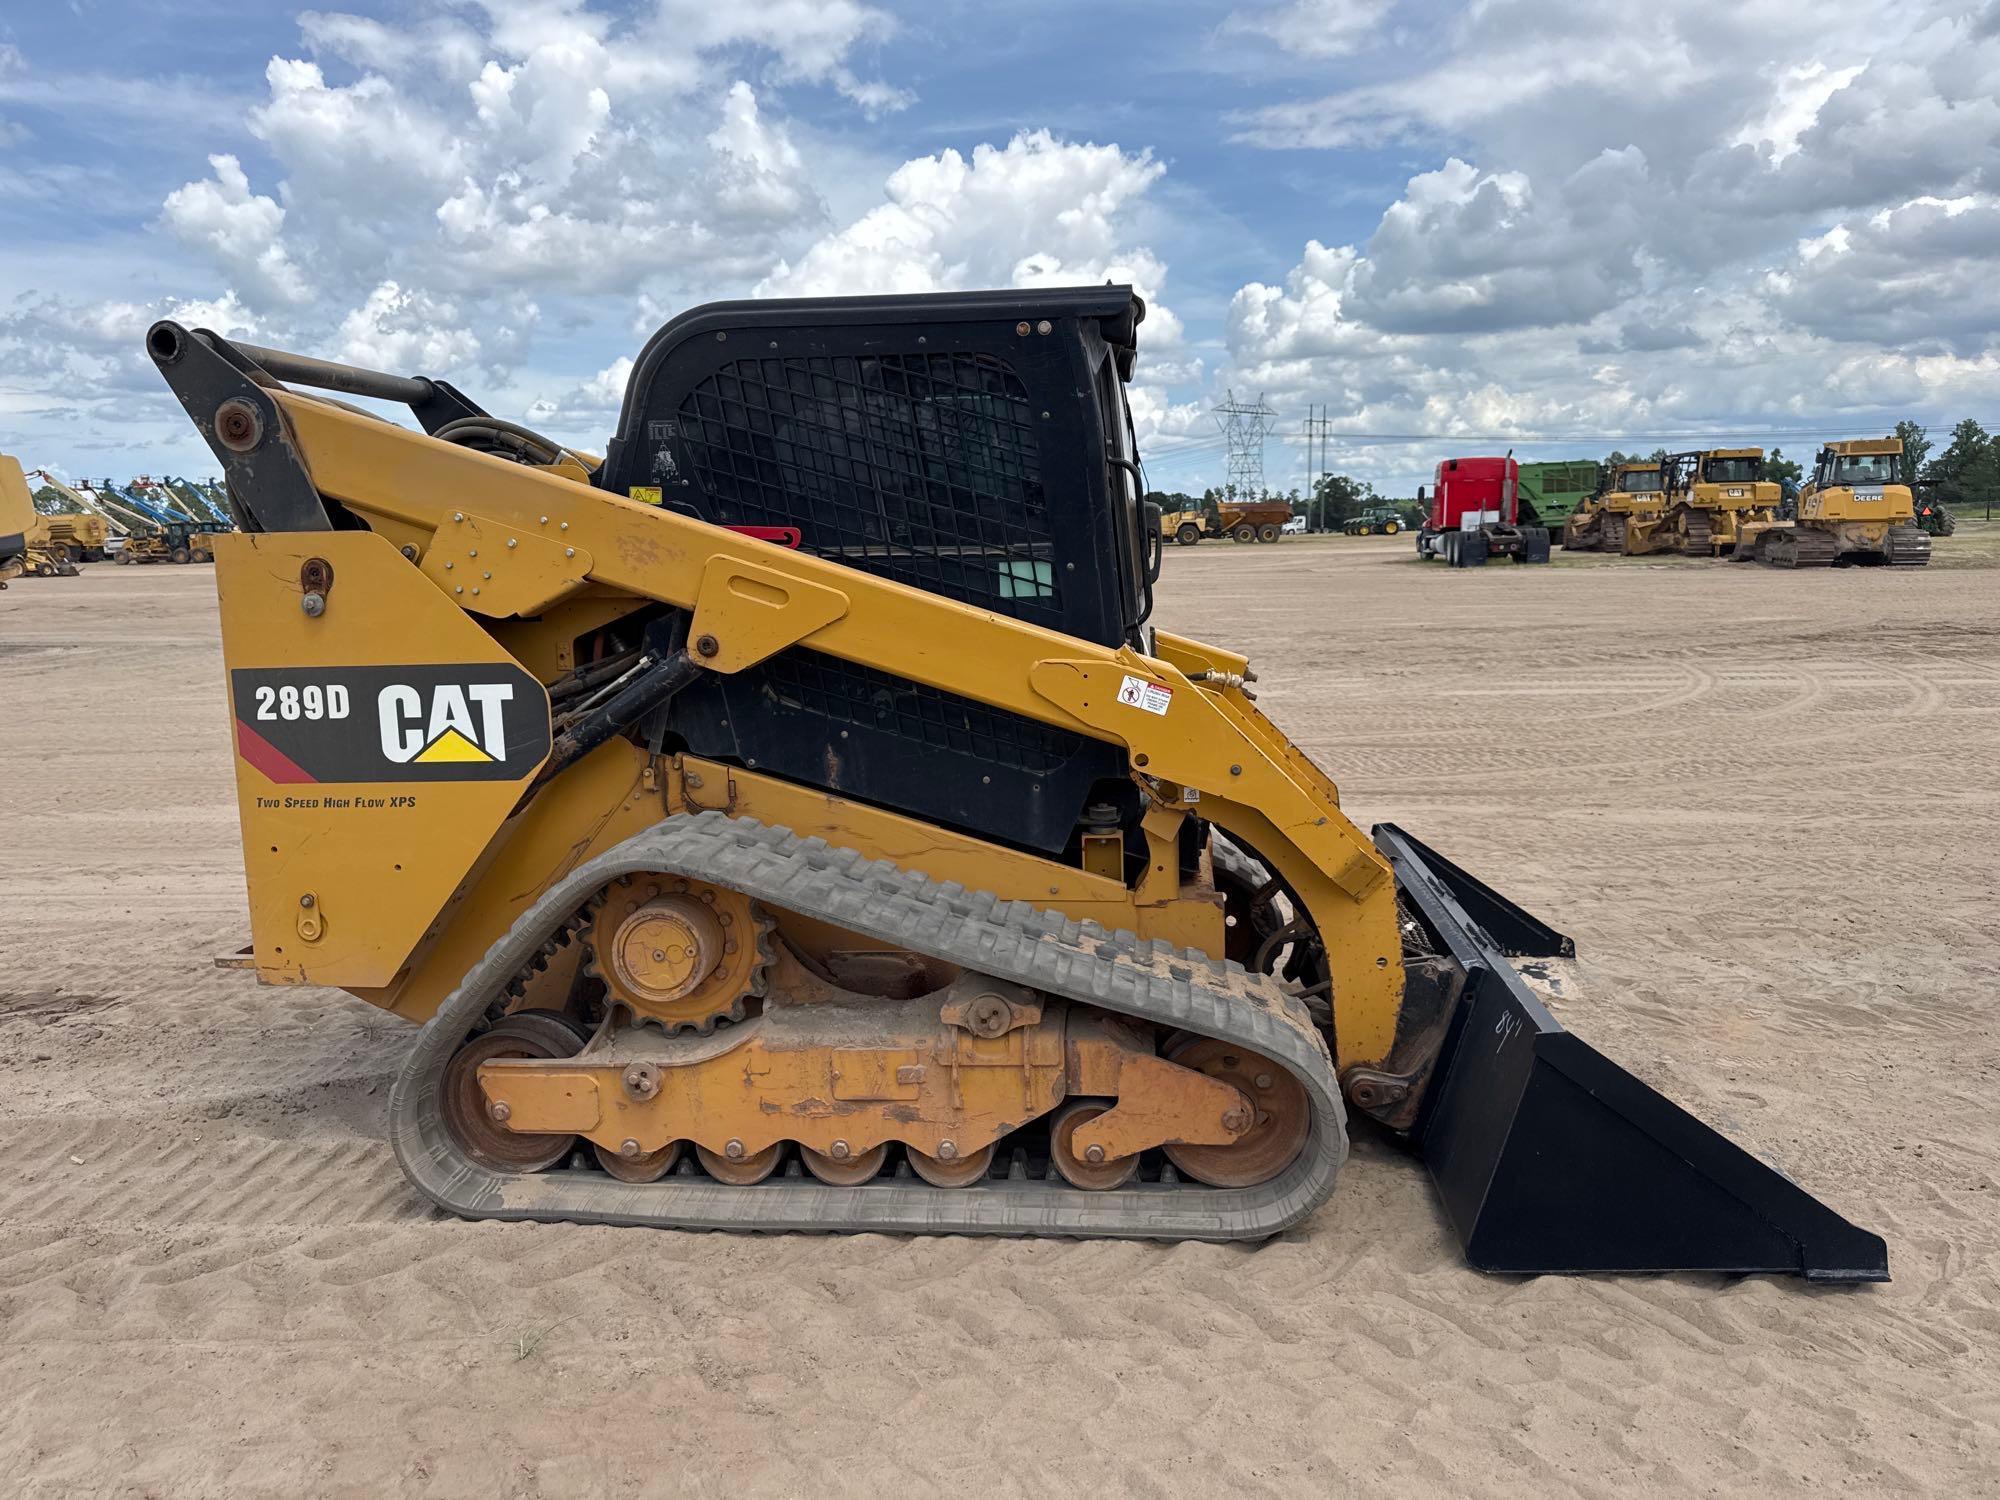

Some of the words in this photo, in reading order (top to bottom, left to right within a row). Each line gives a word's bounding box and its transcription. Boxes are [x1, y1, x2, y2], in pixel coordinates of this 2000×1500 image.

[1853, 494, 1884, 502] DEERE
[255, 685, 351, 721] 289D
[377, 684, 514, 763] CAT
[389, 796, 416, 808] XPS
